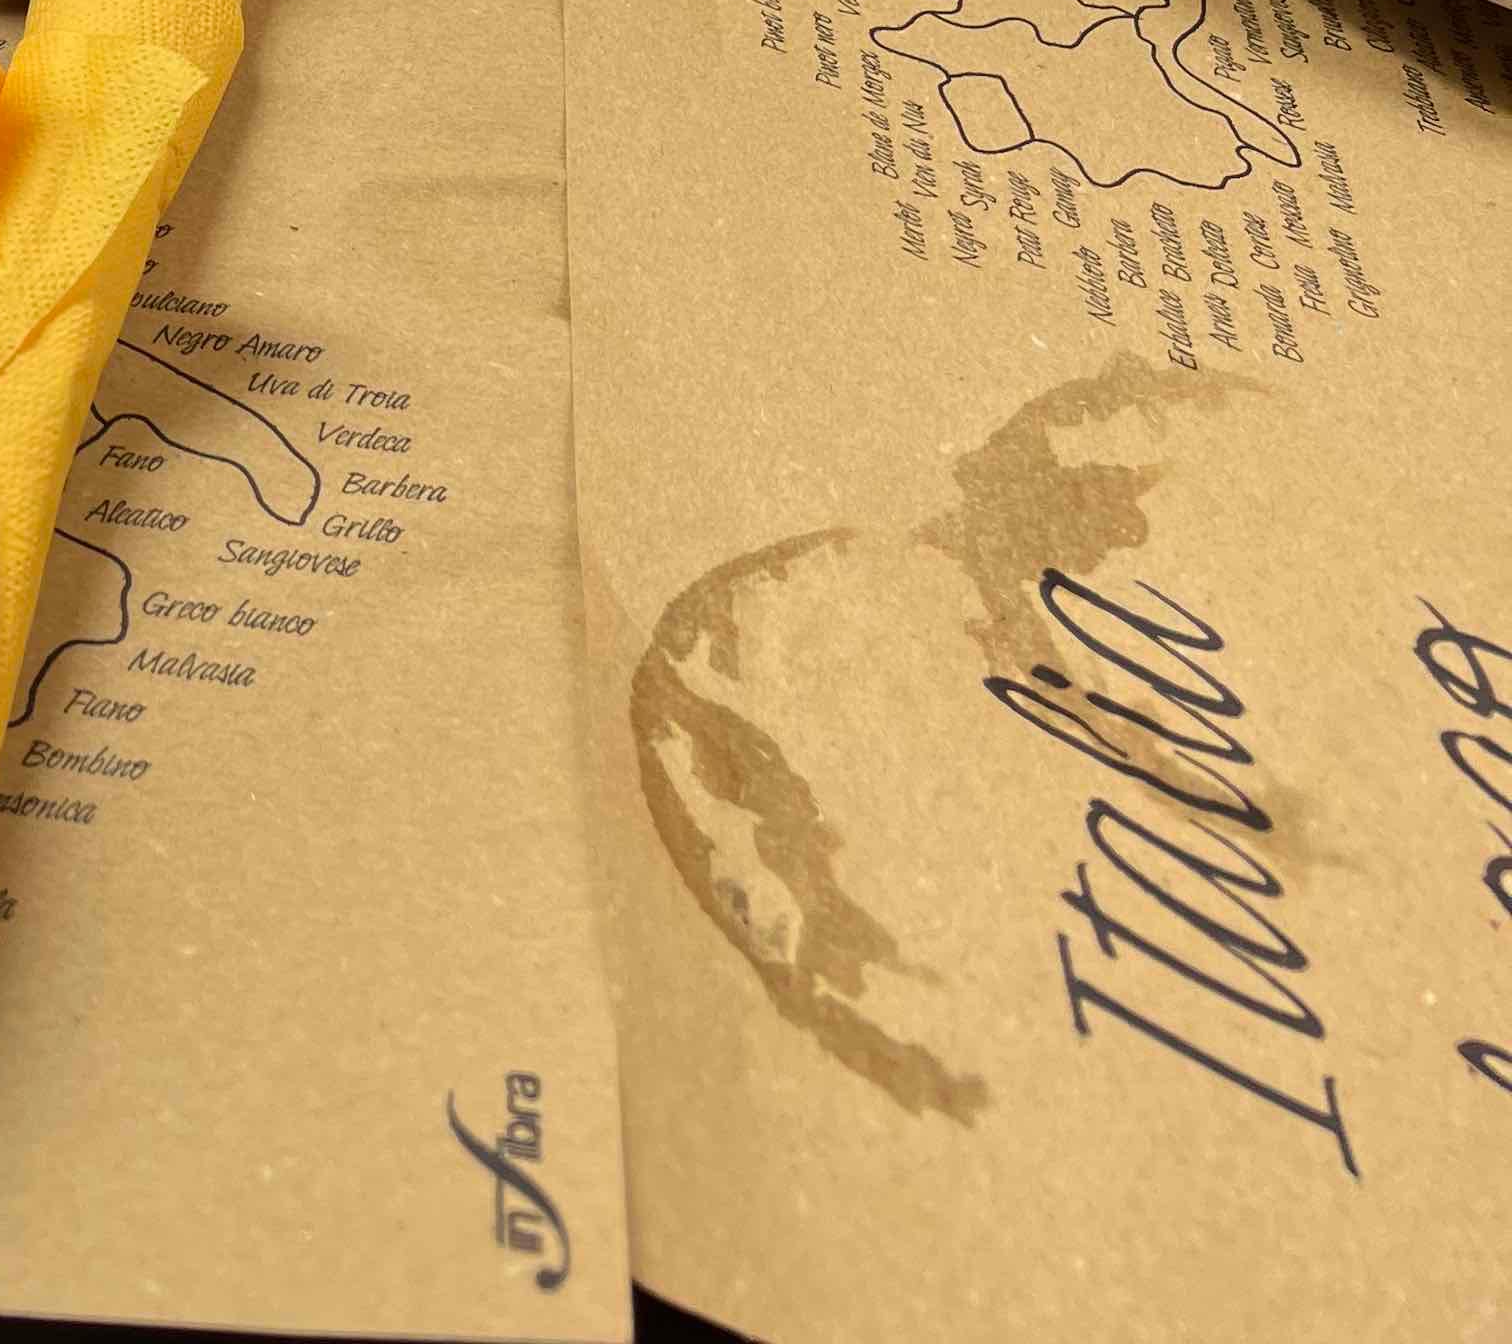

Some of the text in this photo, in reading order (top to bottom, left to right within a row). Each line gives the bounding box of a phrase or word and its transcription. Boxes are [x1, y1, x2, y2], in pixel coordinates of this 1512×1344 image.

[761, 11, 787, 54] Pinot
[813, 11, 841, 89] Pinot nero
[901, 100, 929, 135] Nus
[953, 160, 996, 211] Syrah
[1007, 170, 1040, 226] Rouge
[1050, 167, 1080, 228] Gamay
[894, 199, 928, 261] Merlot
[1273, 179, 1313, 249] Moscato
[1314, 140, 1381, 319] Grignolino Malvasia
[1106, 218, 1147, 288] Barbera
[1072, 245, 1116, 327] Nebbiolo
[1150, 201, 1198, 370] Erbaluce Brachetto
[153, 324, 326, 363] Negro Amaro
[1253, 282, 1304, 363] Bonarda
[248, 372, 411, 411] Uva di Troia
[317, 421, 412, 454] Verdeca
[341, 472, 448, 503] Barbera
[322, 514, 406, 544] Grillo
[218, 539, 362, 577] Sangiovese
[142, 591, 317, 637] Greco bianco
[128, 648, 256, 687] Malvasia
[22, 740, 151, 781] Bombino
[982, 564, 1364, 1182] Italia
